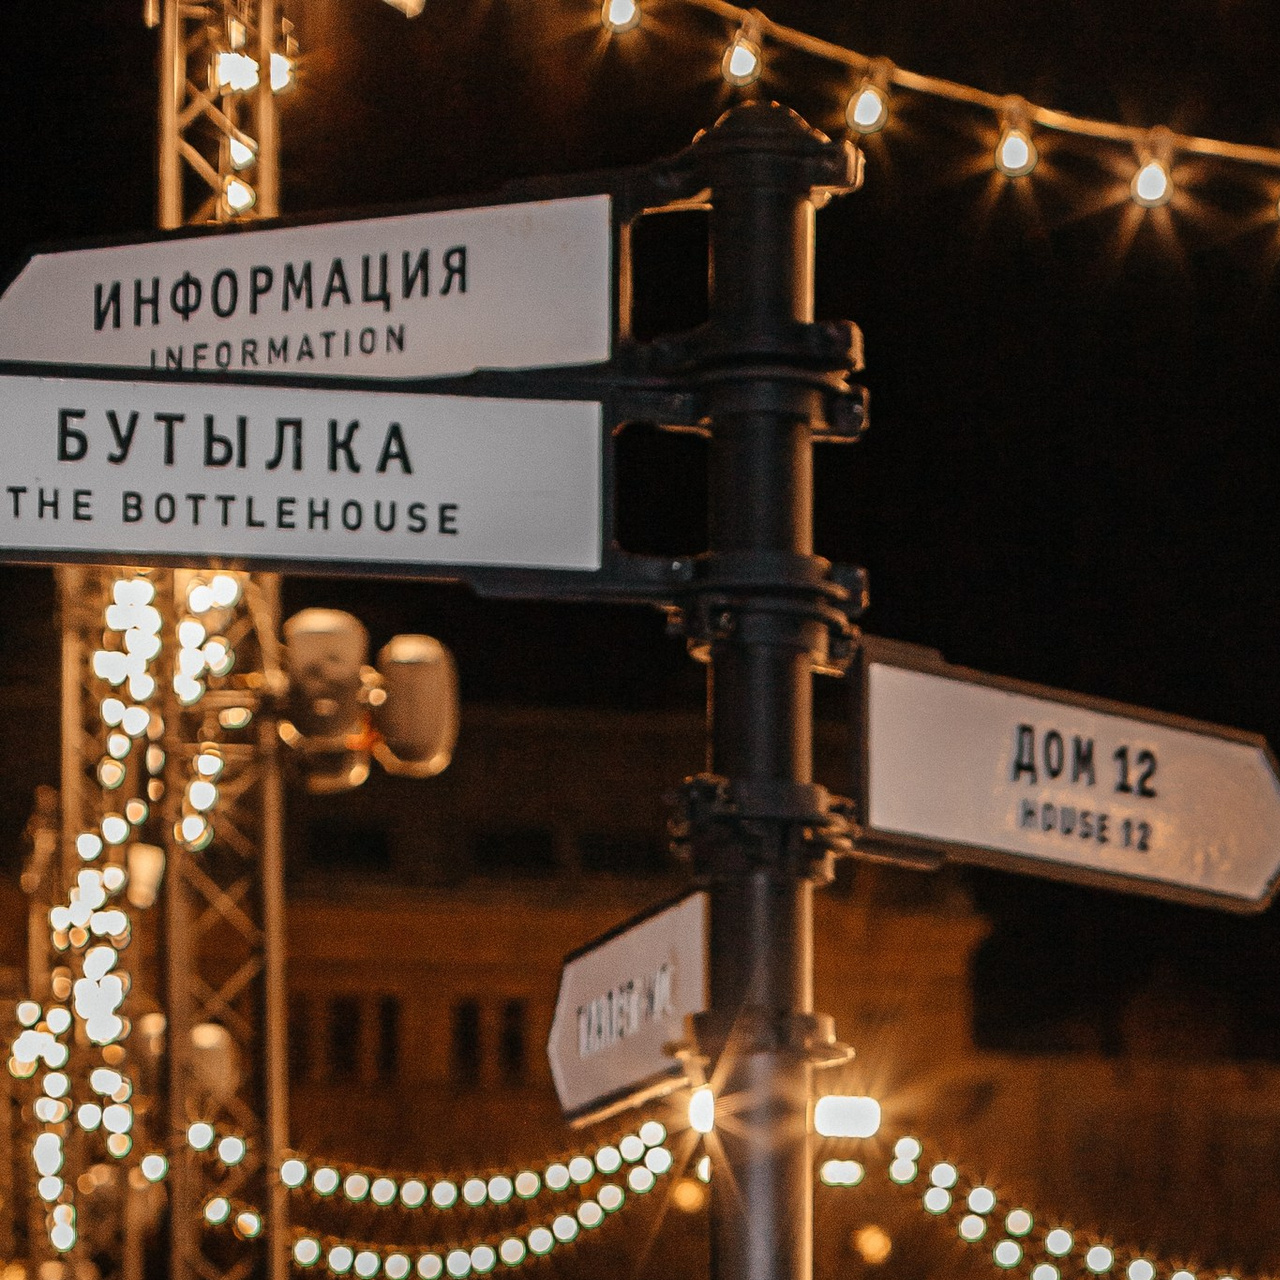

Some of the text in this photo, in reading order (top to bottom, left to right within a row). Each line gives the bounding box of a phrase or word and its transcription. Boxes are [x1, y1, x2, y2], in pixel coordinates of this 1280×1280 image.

[93, 245, 469, 332] ИНФОРМАЦИЯ
[149, 323, 406, 371] INFORMATION
[57, 408, 414, 475] БУТЫЛКА
[6, 486, 460, 536] THE BOTTLEHOUSE
[1012, 723, 1158, 798] ДОМ 12
[1018, 799, 1152, 852] HOUSE 12
